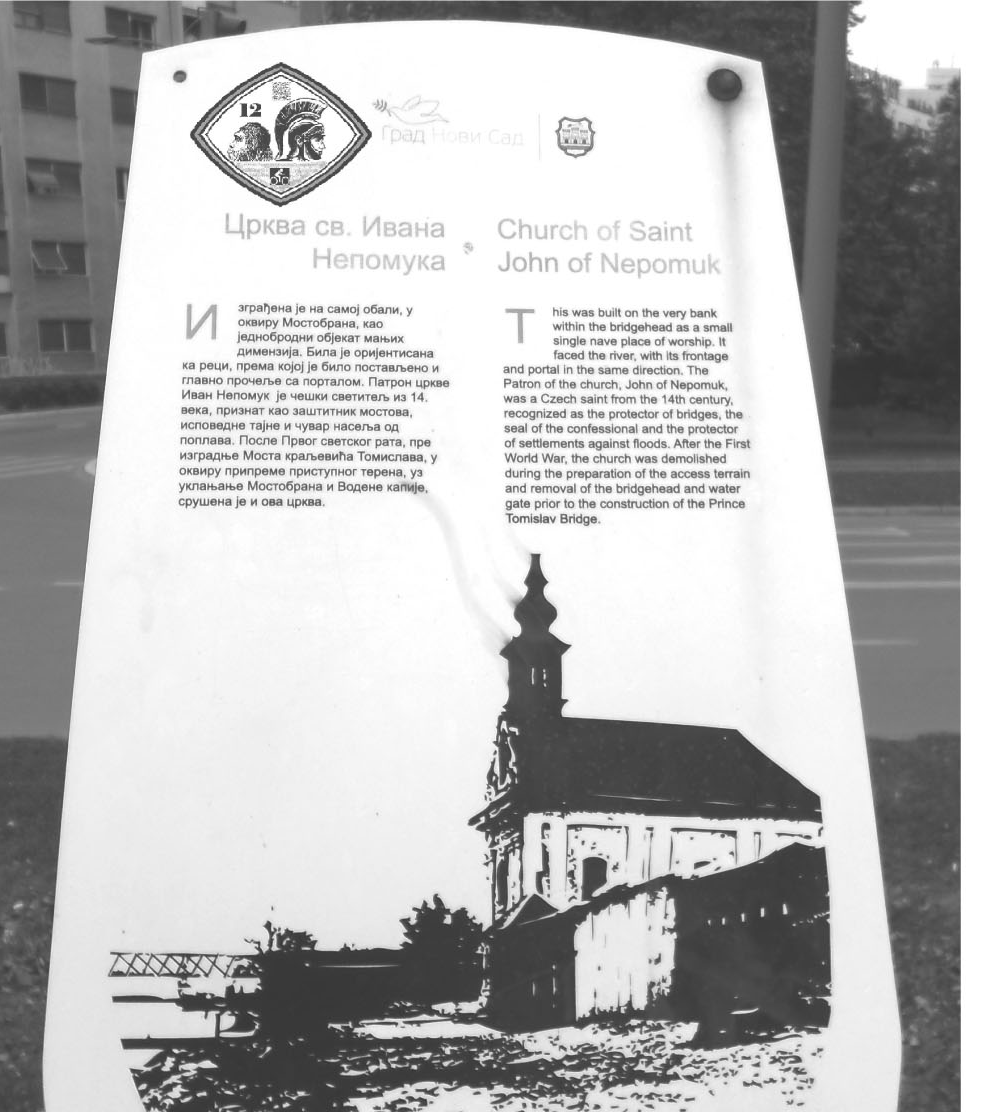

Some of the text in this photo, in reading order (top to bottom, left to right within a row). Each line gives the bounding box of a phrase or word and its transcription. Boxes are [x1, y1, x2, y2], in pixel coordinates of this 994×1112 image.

[240, 103, 261, 117] 12
[381, 124, 523, 146] Град Нови Сад
[225, 212, 444, 239] Црква св. Ивана
[497, 218, 692, 241] Church of Saint
[313, 247, 445, 275] Непомука
[497, 251, 720, 277] John of Nepomuk
[238, 302, 412, 317] зграђена је на самој обали, у
[552, 307, 717, 320] his was built on the very bank
[186, 303, 217, 339] И
[237, 317, 383, 330] оквиру Мостобрана, као
[505, 308, 534, 343] T
[552, 321, 732, 334] within the bridgehead as a small
[178, 496, 324, 508] срушена је и ова црква.
[505, 512, 600, 526] Tomislav Bridge.
